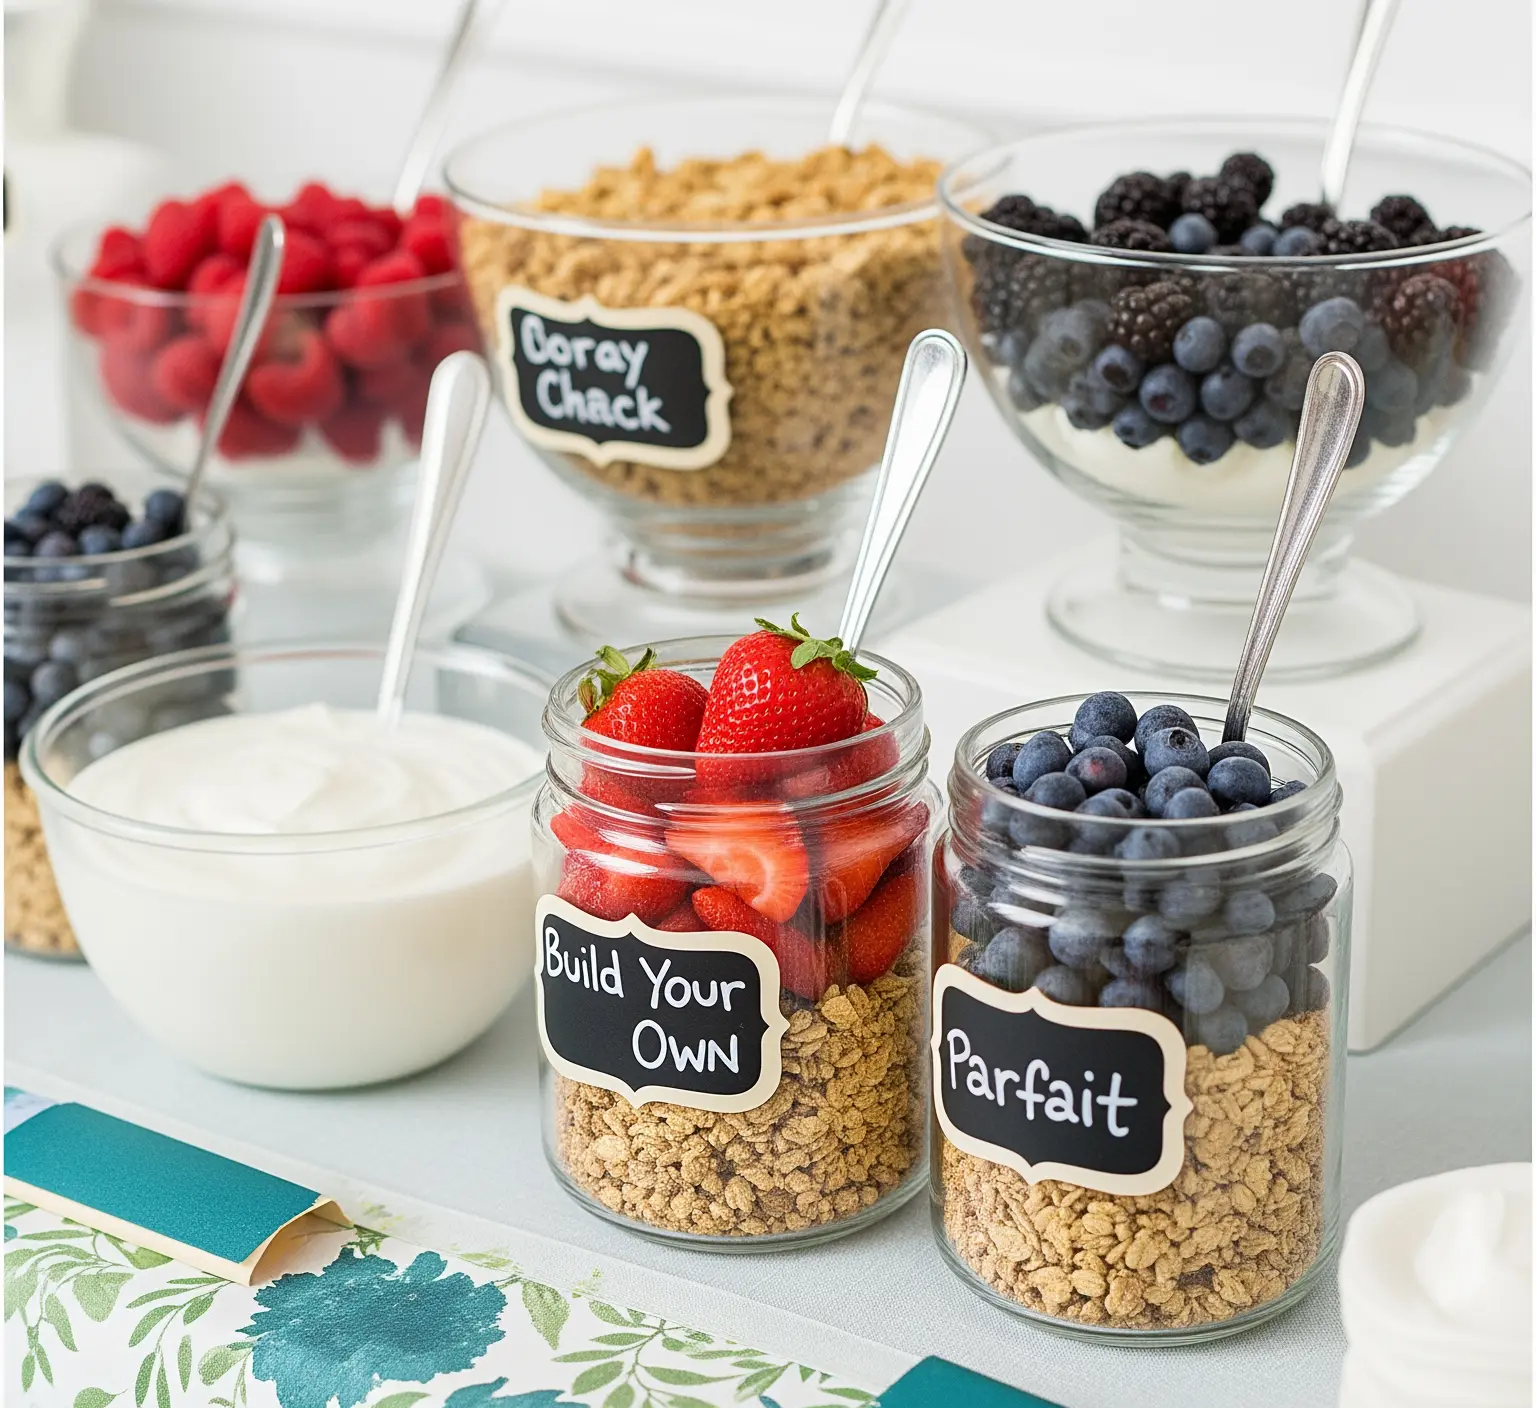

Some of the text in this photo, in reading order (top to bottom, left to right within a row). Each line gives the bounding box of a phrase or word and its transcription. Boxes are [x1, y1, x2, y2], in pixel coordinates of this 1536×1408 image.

[536, 368, 672, 434] Chack
[545, 926, 746, 1012] Build Your
[632, 1019, 740, 1074] OWN
[946, 1028, 1139, 1138] Parfait
